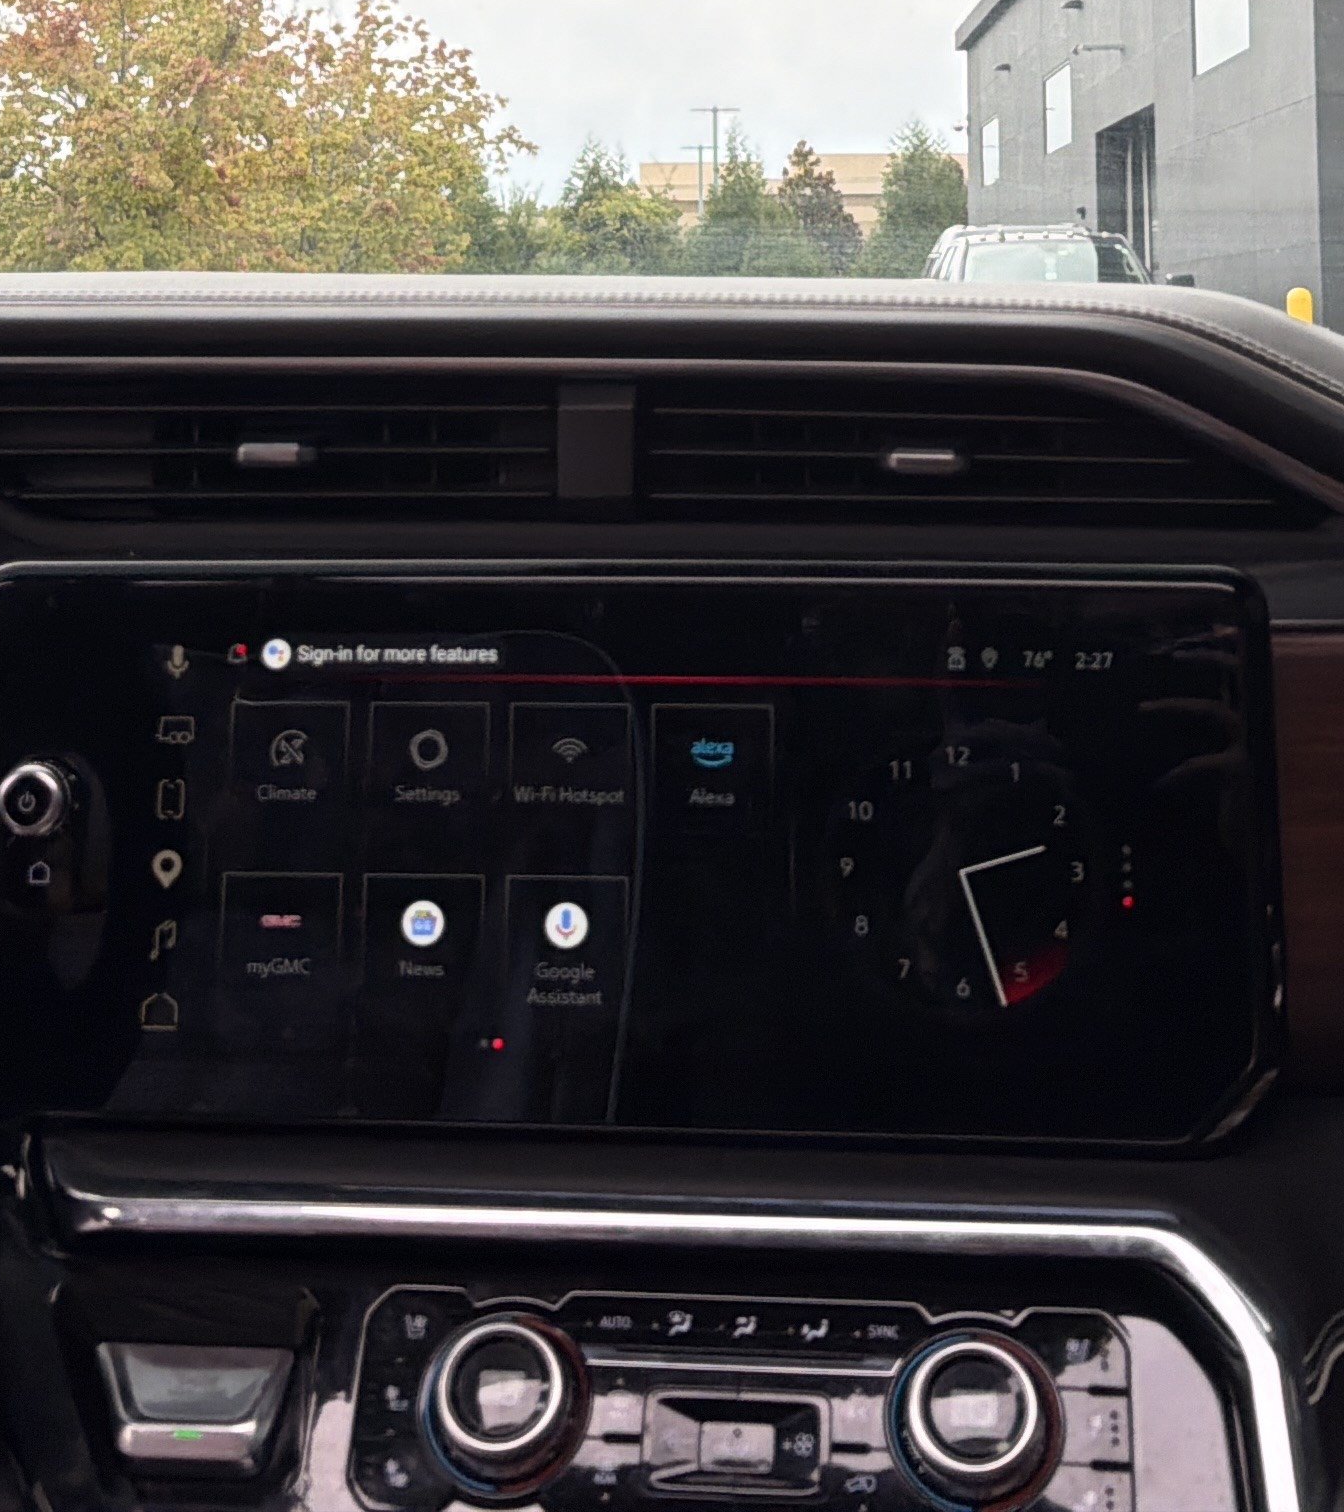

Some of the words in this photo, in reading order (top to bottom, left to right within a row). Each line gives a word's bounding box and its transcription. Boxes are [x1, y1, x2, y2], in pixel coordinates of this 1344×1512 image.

[297, 644, 353, 667] Sign-in
[357, 644, 380, 663] for
[383, 647, 427, 663] more
[430, 644, 499, 663] features
[1074, 651, 1114, 670] 2:27
[690, 738, 735, 755] alexa
[945, 746, 971, 767] 12
[888, 760, 912, 781] 11
[1009, 761, 1021, 783] 1
[257, 784, 317, 802] Climate
[395, 785, 460, 806] Settings
[513, 786, 555, 803] Wi-Fi
[559, 787, 625, 806] Hotspot
[689, 788, 736, 806] Alexa
[848, 800, 874, 821] 10
[1053, 805, 1066, 826] 2
[840, 856, 855, 878] 9
[1071, 861, 1085, 882] 3
[855, 914, 869, 937] 8
[1054, 919, 1069, 938] 4
[246, 958, 311, 978] myGMC
[398, 959, 444, 977] News
[535, 962, 595, 982] Google
[898, 958, 911, 979] 7
[1012, 961, 1029, 982] 5
[526, 987, 602, 1006] Assistant
[958, 976, 972, 999] 6
[598, 1315, 632, 1330] AUTO
[868, 1323, 901, 1338] SYNC
